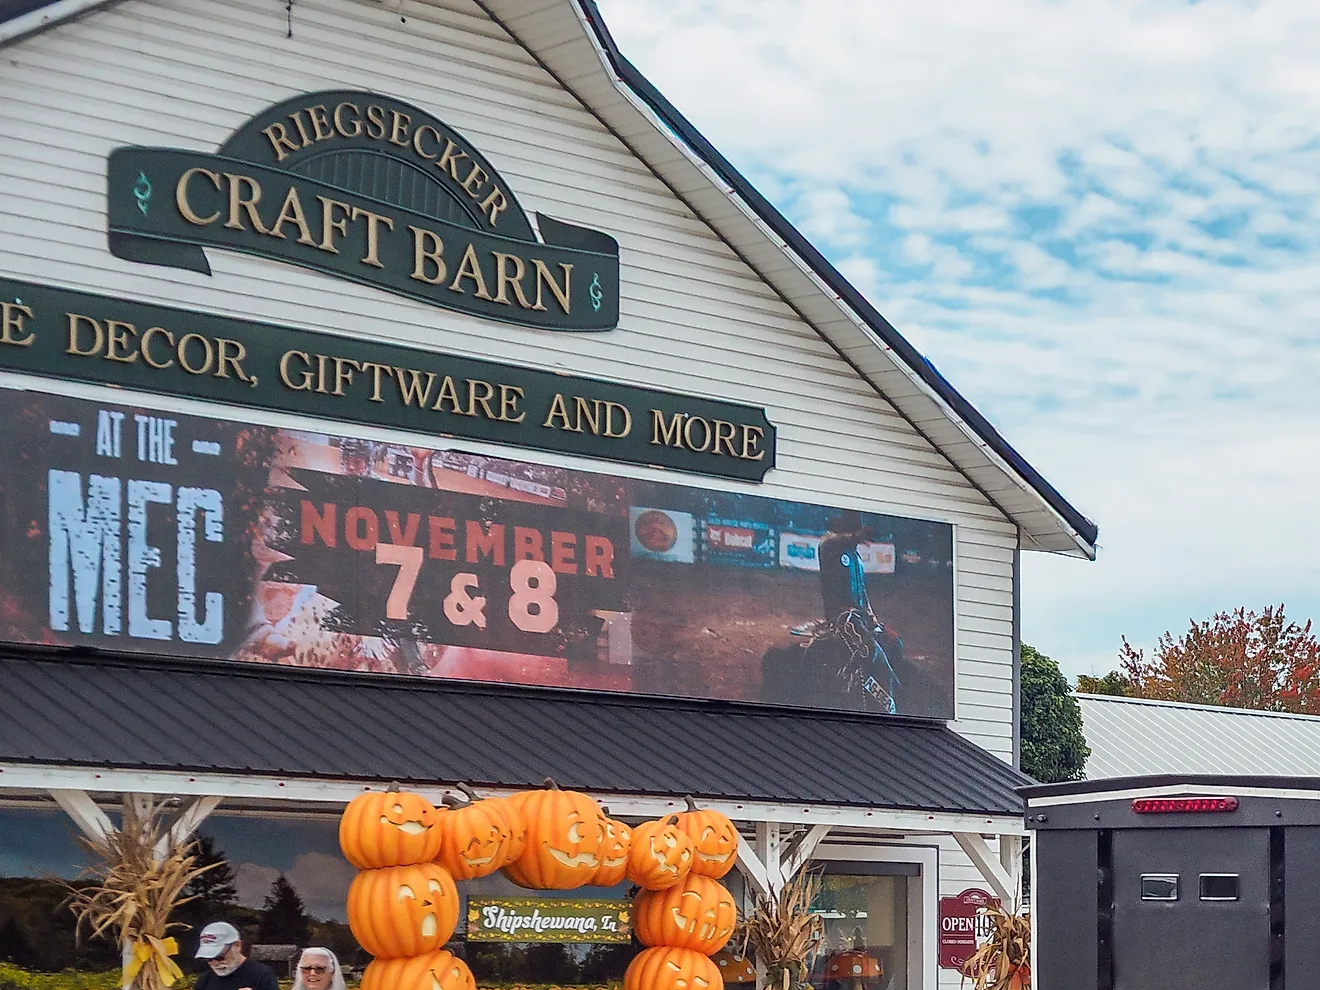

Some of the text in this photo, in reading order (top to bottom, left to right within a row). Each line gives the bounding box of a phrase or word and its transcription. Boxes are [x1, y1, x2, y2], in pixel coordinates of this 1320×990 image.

[261, 102, 508, 226] RIEGSECKER
[175, 166, 574, 315] CRAFT BARN
[65, 312, 258, 388] DECOR,
[279, 349, 525, 424] GIFTWARE
[542, 393, 632, 440] AND
[651, 409, 766, 462] MORE
[96, 410, 178, 466] AT THE
[48, 468, 224, 645] MEC
[300, 500, 616, 580] NOVEMBER
[375, 542, 558, 634] 7 & 8
[482, 905, 617, 934] Shipshewana, In
[942, 917, 974, 931] OPEN
